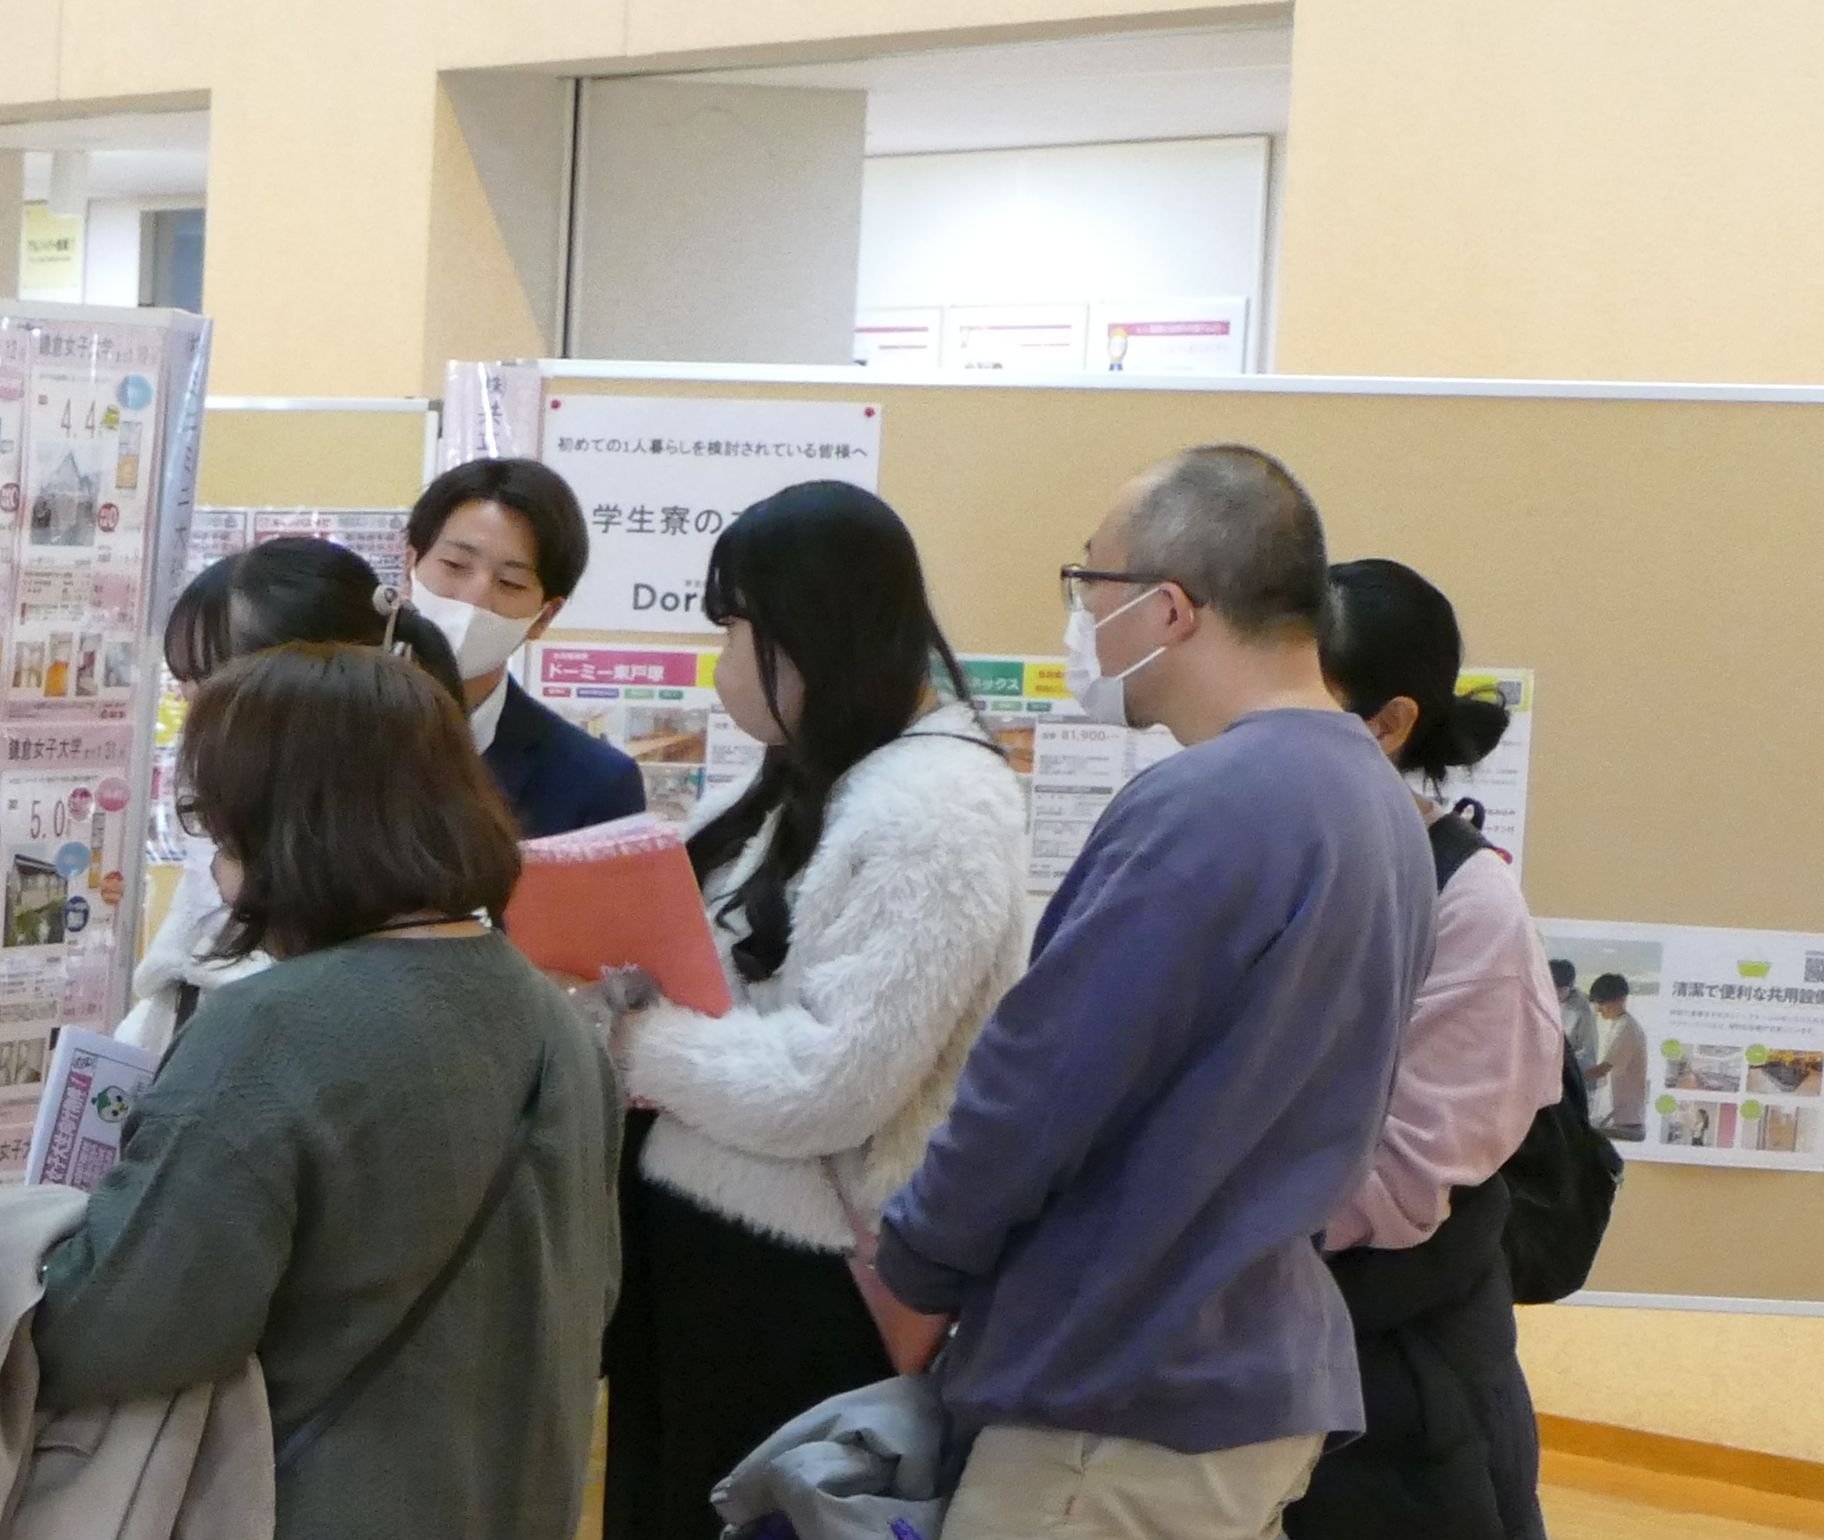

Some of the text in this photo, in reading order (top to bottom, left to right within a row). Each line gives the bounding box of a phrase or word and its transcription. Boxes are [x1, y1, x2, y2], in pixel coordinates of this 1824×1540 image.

[592, 503, 744, 537] 学生寮の
[632, 582, 706, 614] Dor
[30, 799, 66, 839] 5.0
